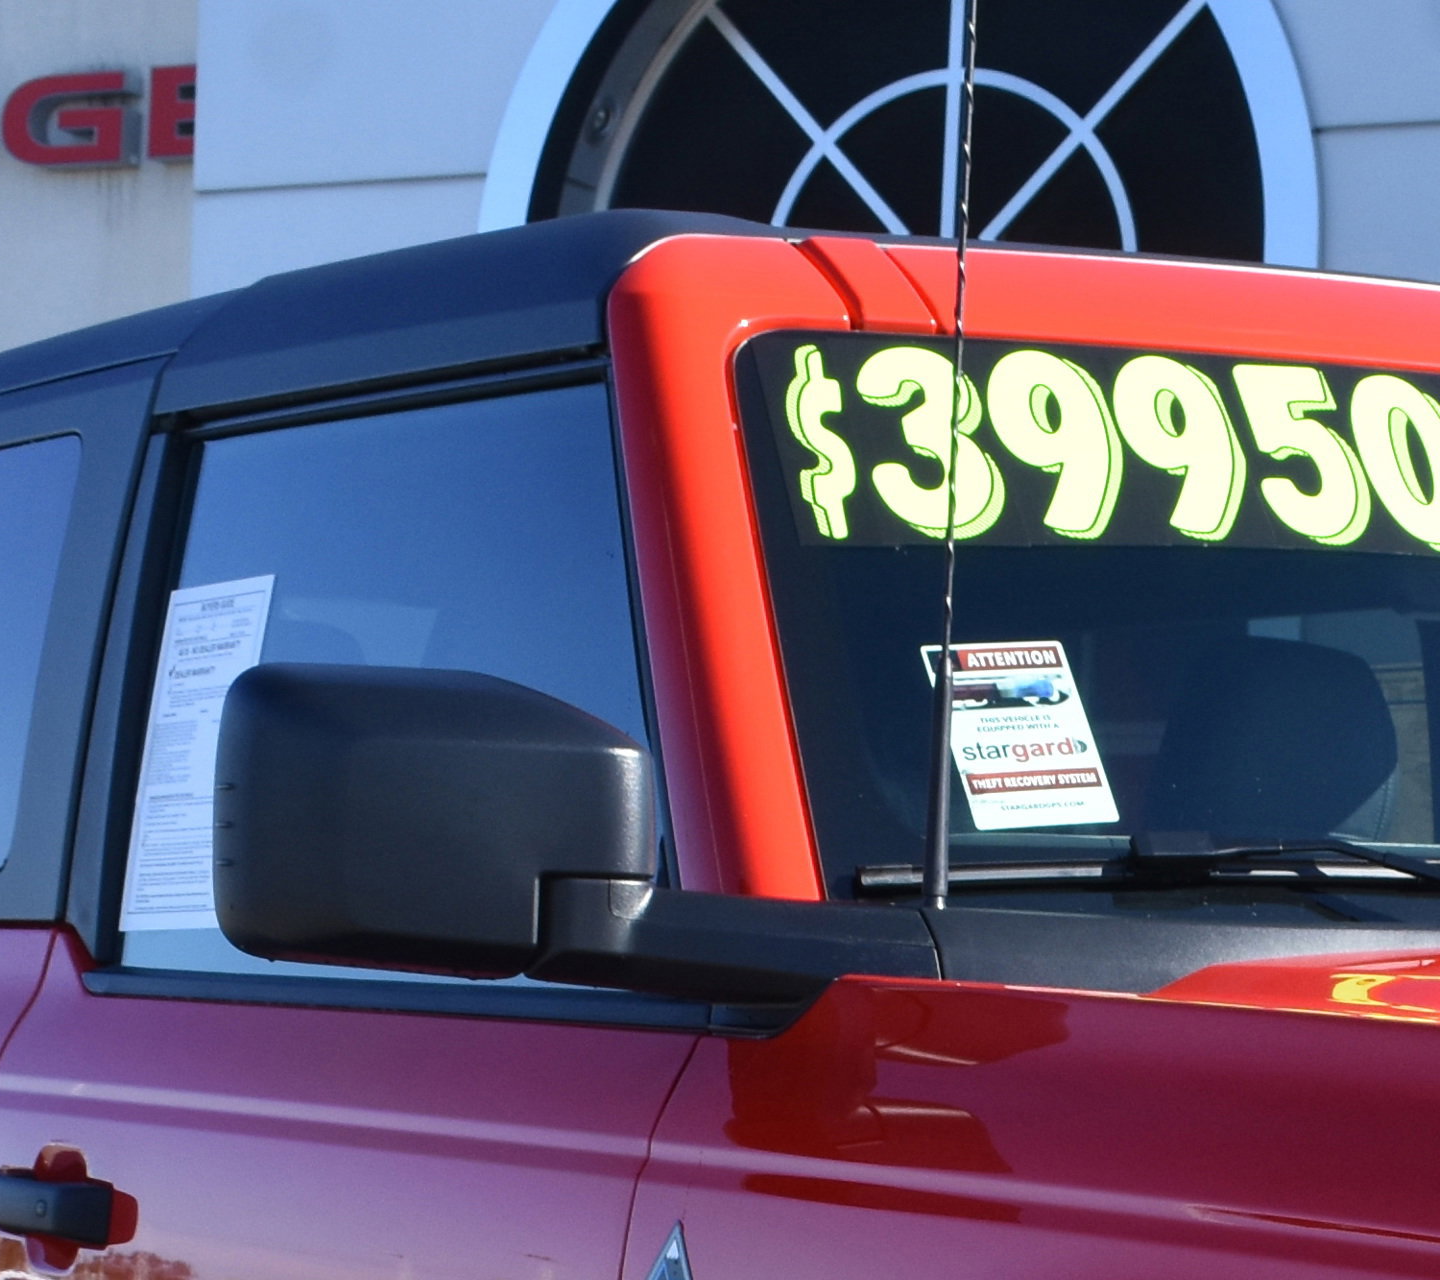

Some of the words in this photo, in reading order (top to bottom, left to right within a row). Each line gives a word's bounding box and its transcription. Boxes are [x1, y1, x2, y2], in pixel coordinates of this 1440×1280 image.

[967, 650, 1057, 667] ATTENTION
[962, 737, 1074, 763] stargard
[971, 777, 1003, 790] THEFT
[1003, 775, 1057, 788] RECOVERY
[1057, 773, 1098, 785] SYSTEM
